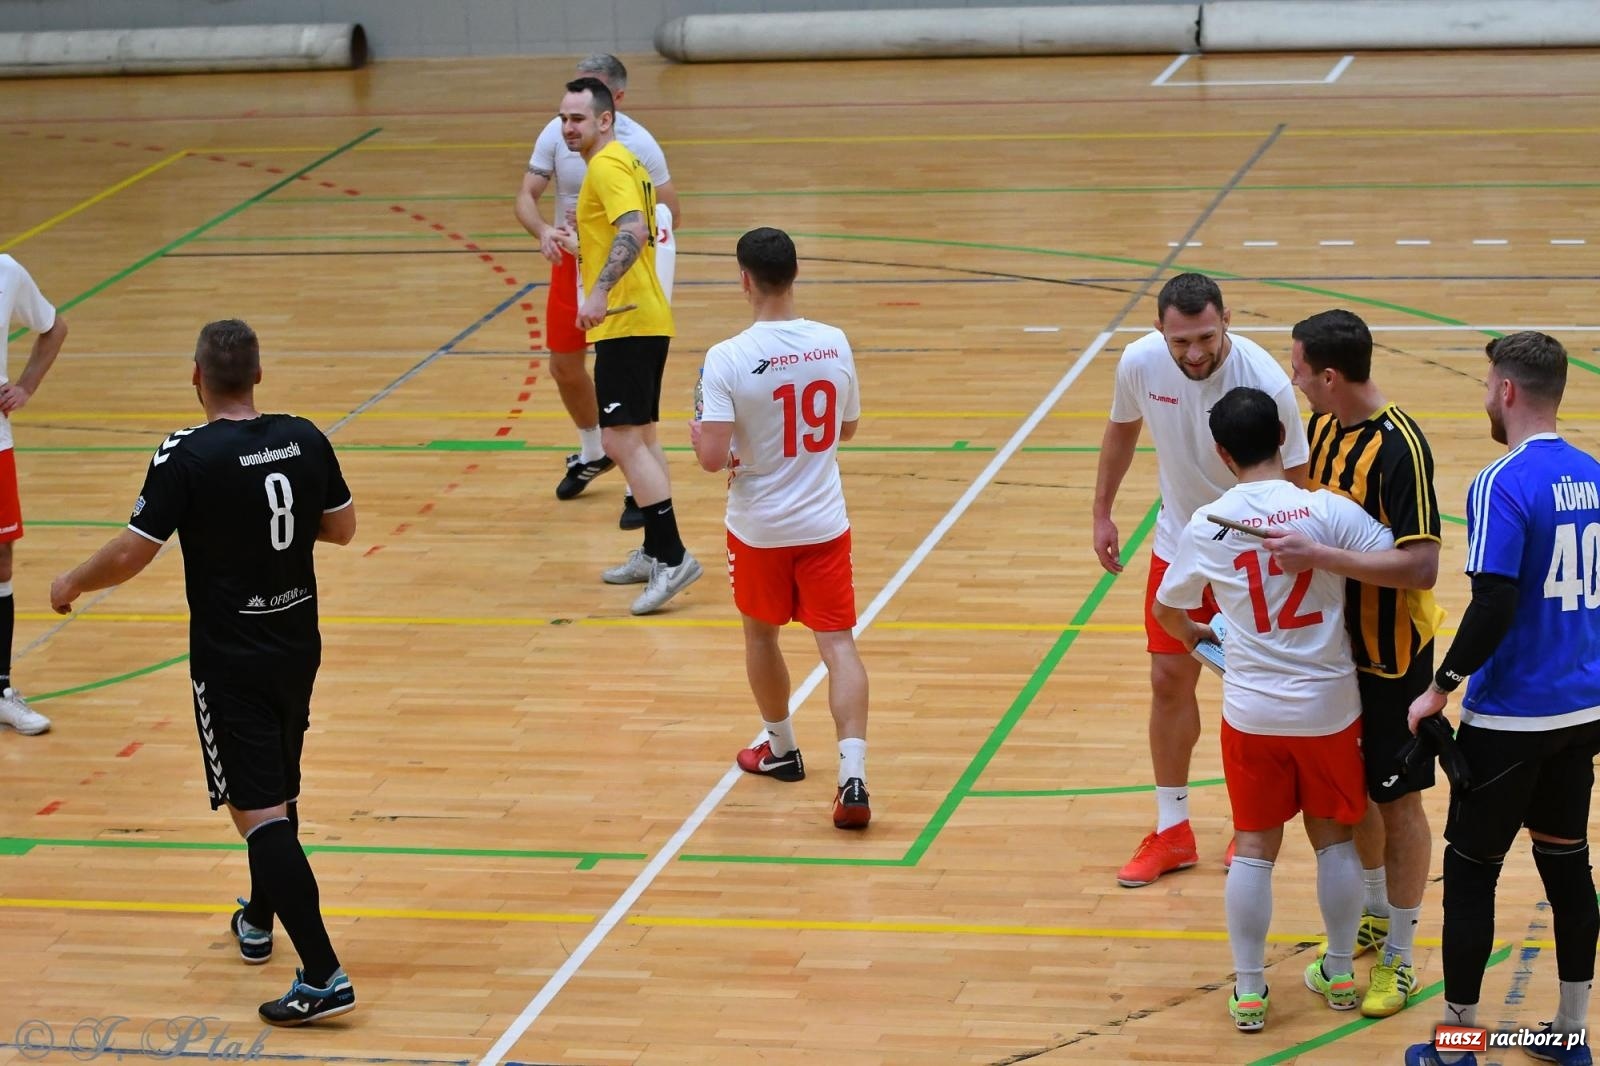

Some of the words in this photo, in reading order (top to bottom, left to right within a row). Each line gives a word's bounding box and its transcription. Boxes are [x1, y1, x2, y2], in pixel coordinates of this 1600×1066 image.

[771, 354, 799, 367] PRD
[803, 348, 839, 362] KÜHN
[1148, 391, 1179, 405] hummel
[773, 379, 836, 457] 19
[239, 441, 301, 467] woniakowski
[264, 472, 295, 551] 8
[1551, 475, 1600, 512] KÜHN
[1267, 506, 1311, 527] KÜHN
[1543, 522, 1600, 612] 40
[1233, 549, 1324, 634] 12
